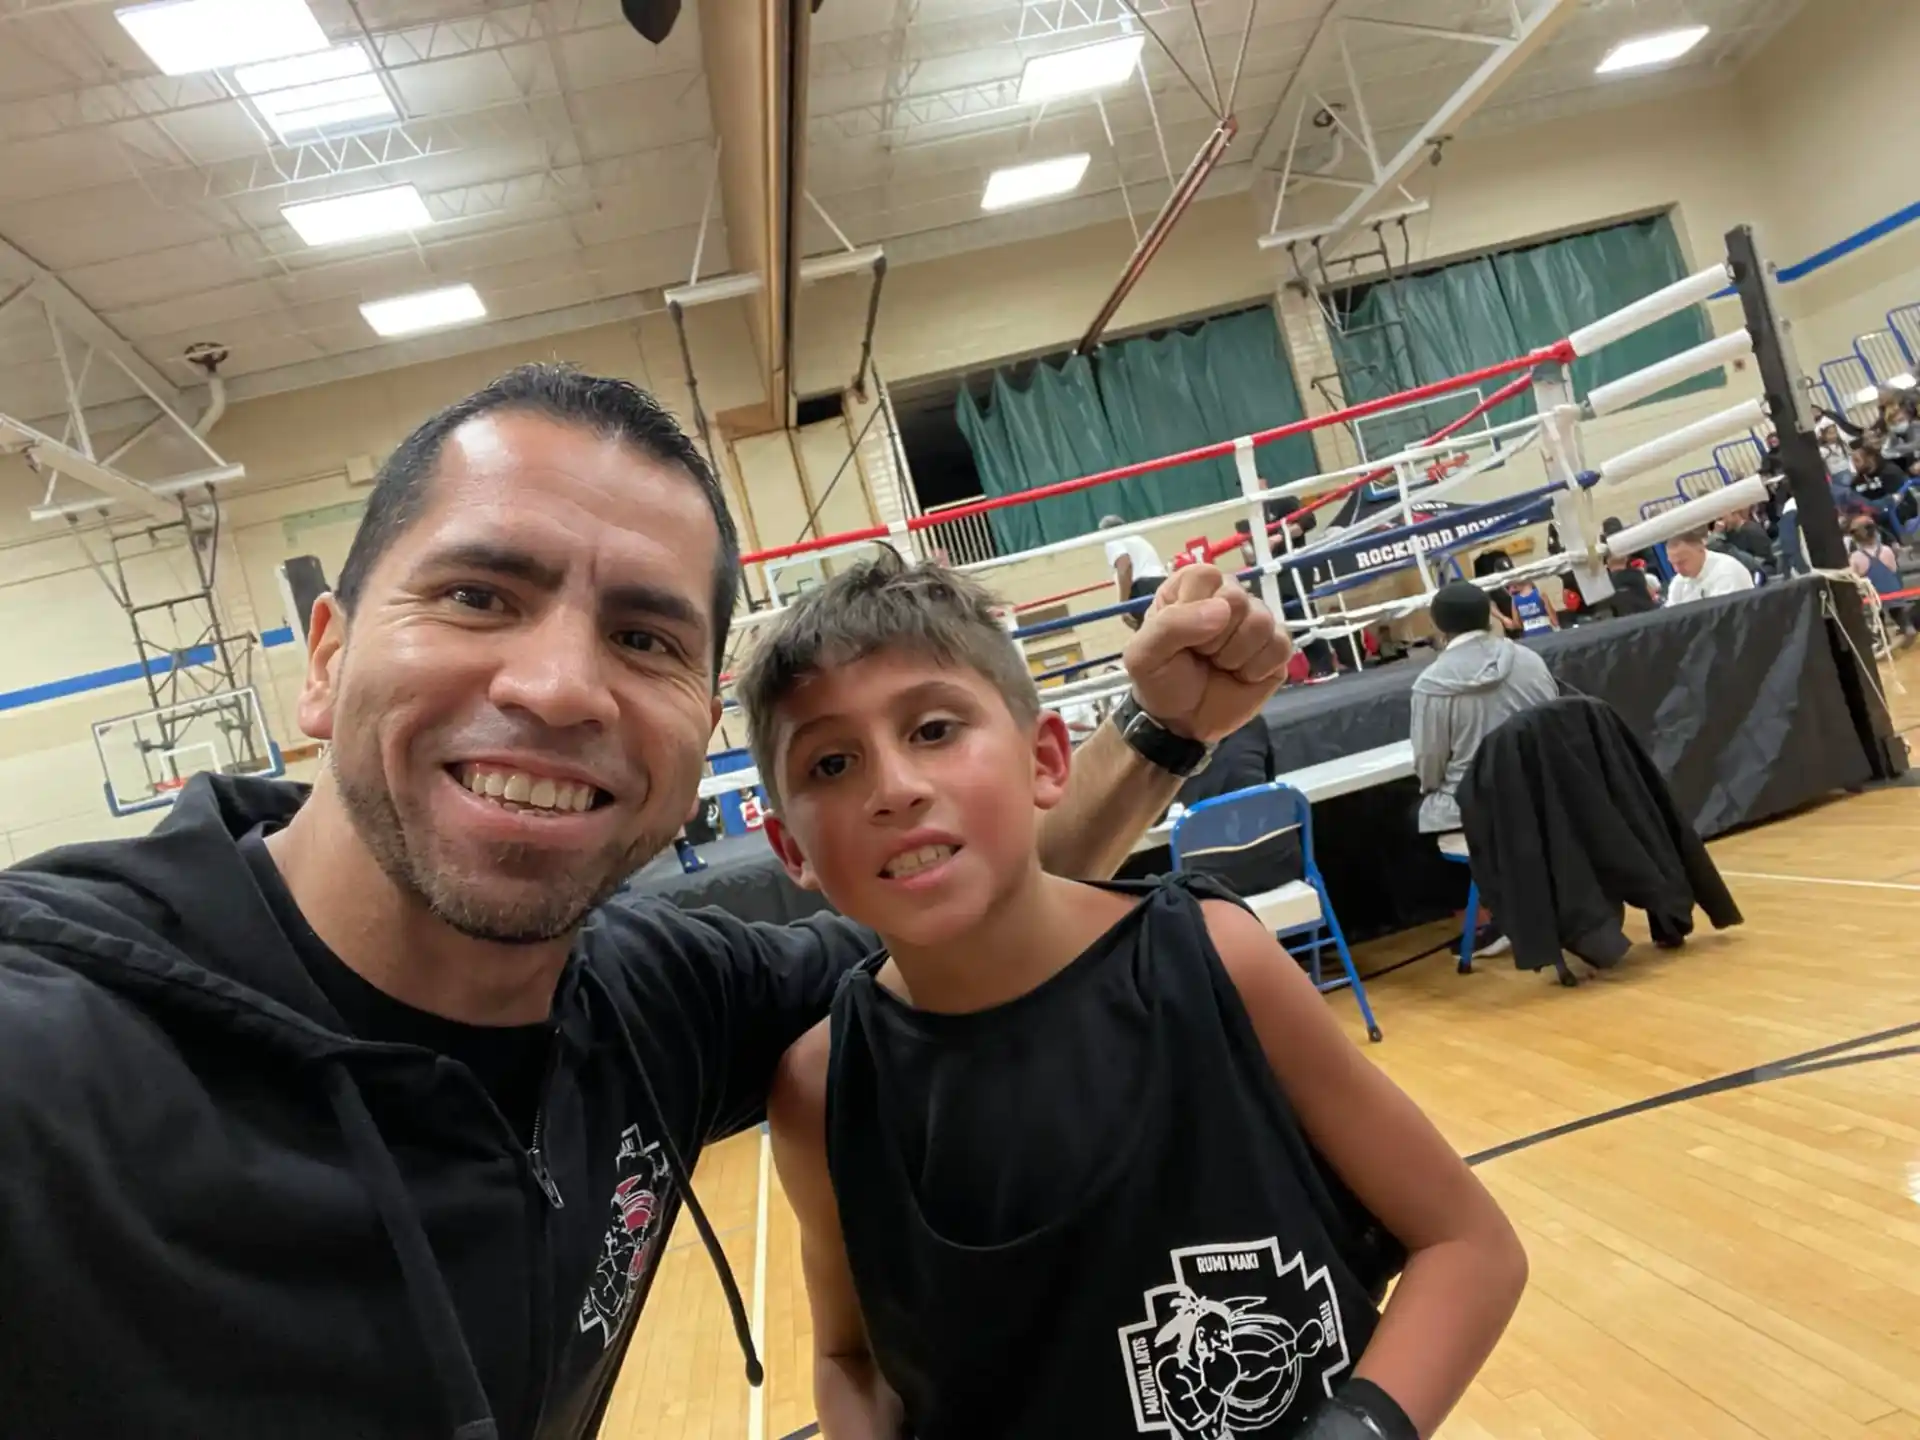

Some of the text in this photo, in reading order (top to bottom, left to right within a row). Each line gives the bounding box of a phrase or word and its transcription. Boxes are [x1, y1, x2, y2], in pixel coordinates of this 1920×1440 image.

[1196, 1252, 1260, 1273] RUMI MAKI
[1132, 1337, 1161, 1415] MARTIAL ARTS
